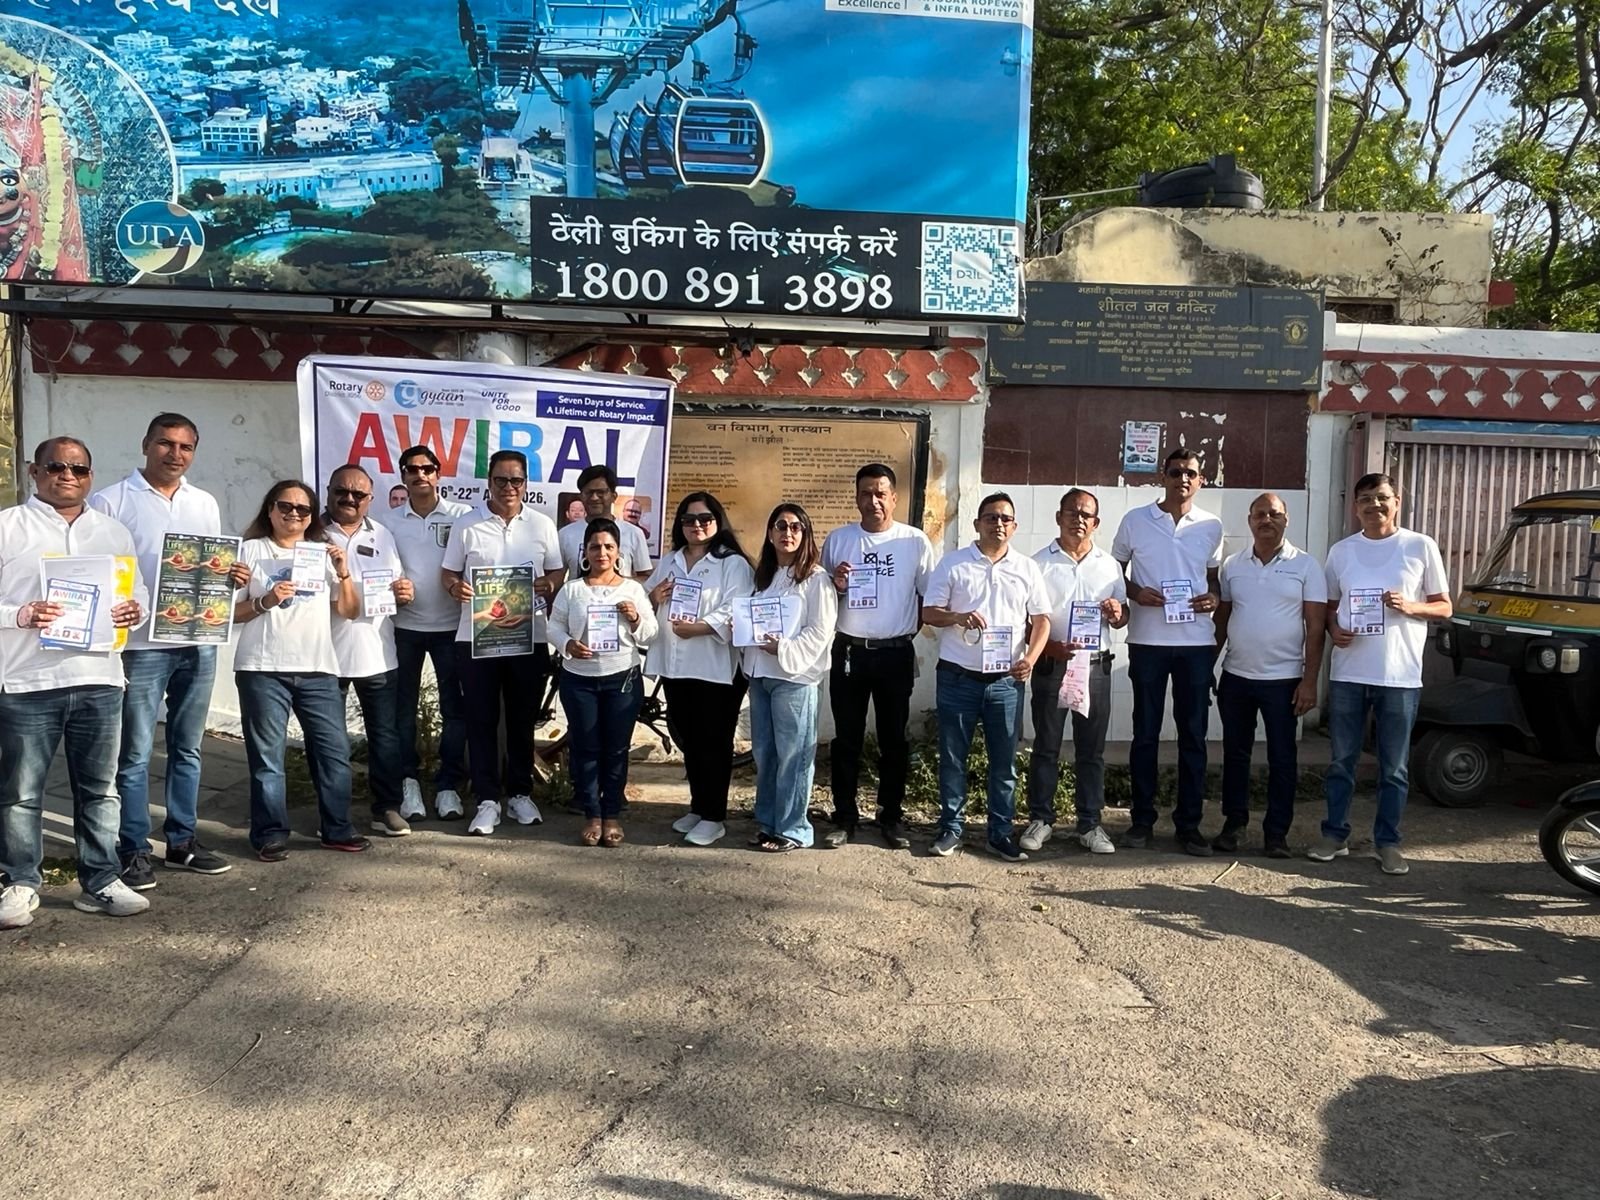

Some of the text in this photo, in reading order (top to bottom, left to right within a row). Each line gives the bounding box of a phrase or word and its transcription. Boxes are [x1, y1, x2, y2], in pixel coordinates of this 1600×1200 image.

[838, 0, 901, 9] Excellence
[935, 5, 969, 14] INFRA
[973, 7, 1018, 18] LIMITED
[126, 223, 196, 248] UDA
[609, 216, 688, 255] बुकिंग
[693, 219, 721, 250] के
[785, 224, 852, 256] संपर्क
[857, 227, 899, 257] करें
[556, 261, 894, 314] 1800 891 3898
[1098, 296, 1217, 314] शीतल जल मन्दिर
[329, 380, 363, 394] Rotary
[420, 390, 464, 405] gyaan
[558, 395, 646, 409] Seven Days of Service.
[495, 404, 521, 412] GOOD
[546, 405, 554, 414] A
[554, 406, 587, 416] Lifetime
[588, 409, 598, 417] of
[599, 409, 625, 421] Rotary
[707, 423, 726, 432] वन
[778, 425, 832, 434] राजस्थान
[347, 412, 636, 488] AWIRAL
[876, 566, 895, 577] ECE
[52, 589, 88, 601] AWIRAL
[479, 583, 504, 595] LIFE
